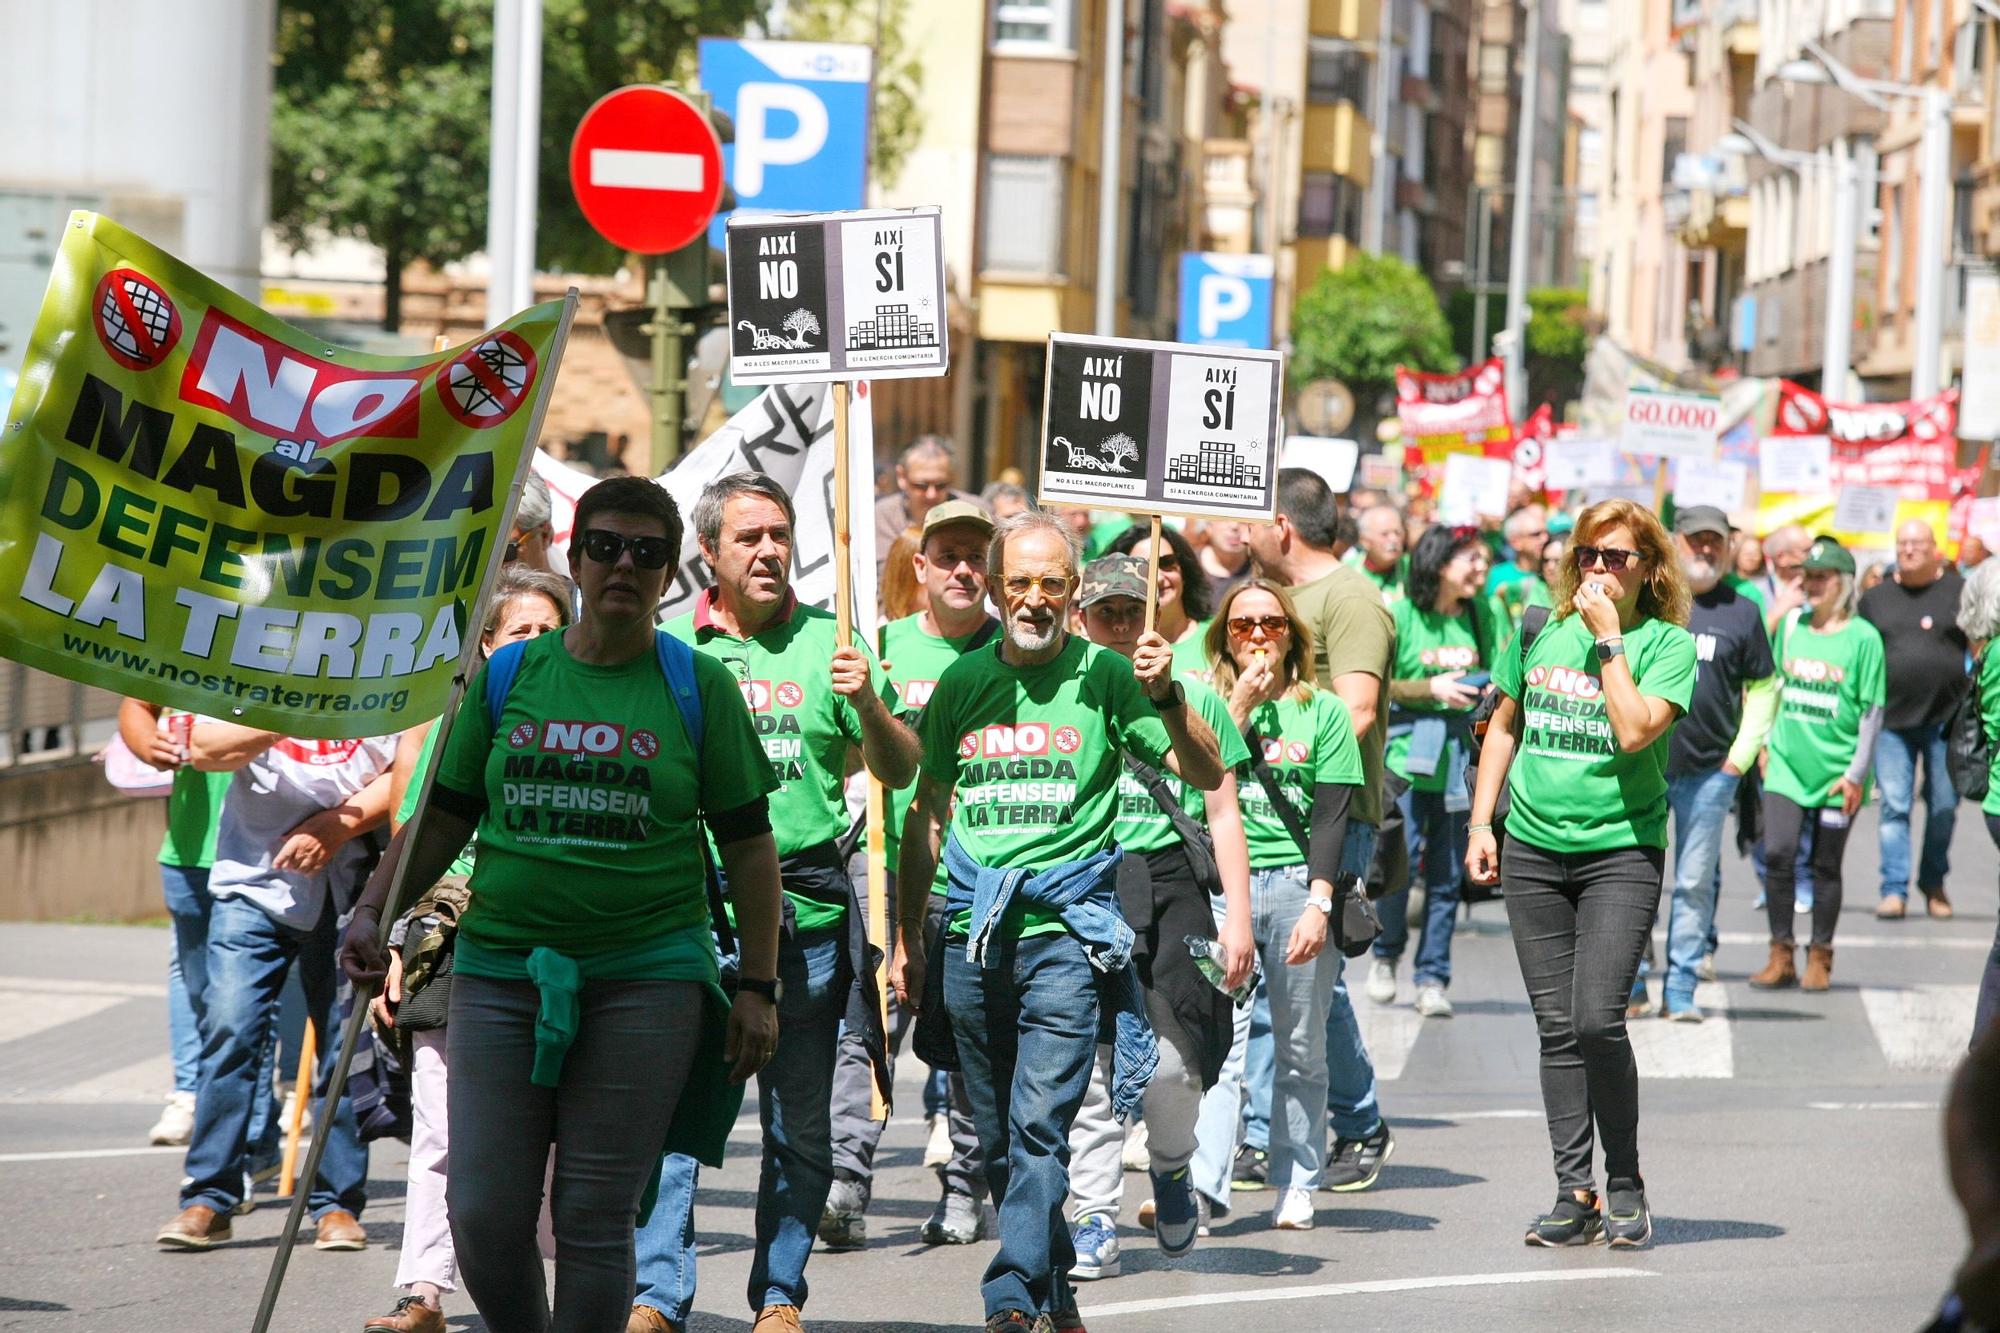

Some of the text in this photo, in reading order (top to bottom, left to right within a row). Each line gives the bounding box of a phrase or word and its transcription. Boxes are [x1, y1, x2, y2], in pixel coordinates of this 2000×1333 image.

[733, 81, 829, 198] P
[759, 231, 796, 256] AIXÍ
[874, 227, 904, 246] AIXÍ
[759, 260, 799, 300] NO
[875, 245, 904, 293] SÍ
[1198, 273, 1252, 339] P
[196, 325, 417, 438] NO
[1083, 355, 1123, 379] AIXÍ
[1205, 367, 1237, 385] AIXÍ
[1080, 381, 1121, 422] NO
[1202, 385, 1235, 431] SÍ
[1628, 399, 1716, 431] 60.000
[65, 373, 495, 522] MAGDA
[273, 437, 316, 464] al
[1085, 480, 1135, 490] MACROPLANTES
[1215, 491, 1258, 501] COMUNITARIA
[41, 457, 487, 600] DEFENSEM
[19, 532, 464, 680] LA TERRA
[1438, 646, 1473, 666] NO
[62, 632, 409, 712] www.nostraterra.org
[1548, 667, 1600, 698] NO
[740, 682, 768, 709] O
[544, 723, 619, 753] NO
[1525, 710, 1613, 738] DEFENSEM
[986, 725, 1046, 754] NO
[1546, 731, 1616, 756] TERRA
[572, 752, 585, 762] al
[503, 755, 652, 791] MAGDA
[964, 759, 1077, 785] MAGDA
[503, 783, 650, 817] DEFENSEM
[964, 783, 1077, 806] DEFENSEM
[504, 808, 648, 842] LA TERRA
[966, 804, 1074, 828] LA TERRA
[516, 834, 628, 850] www.nostraterra.org
